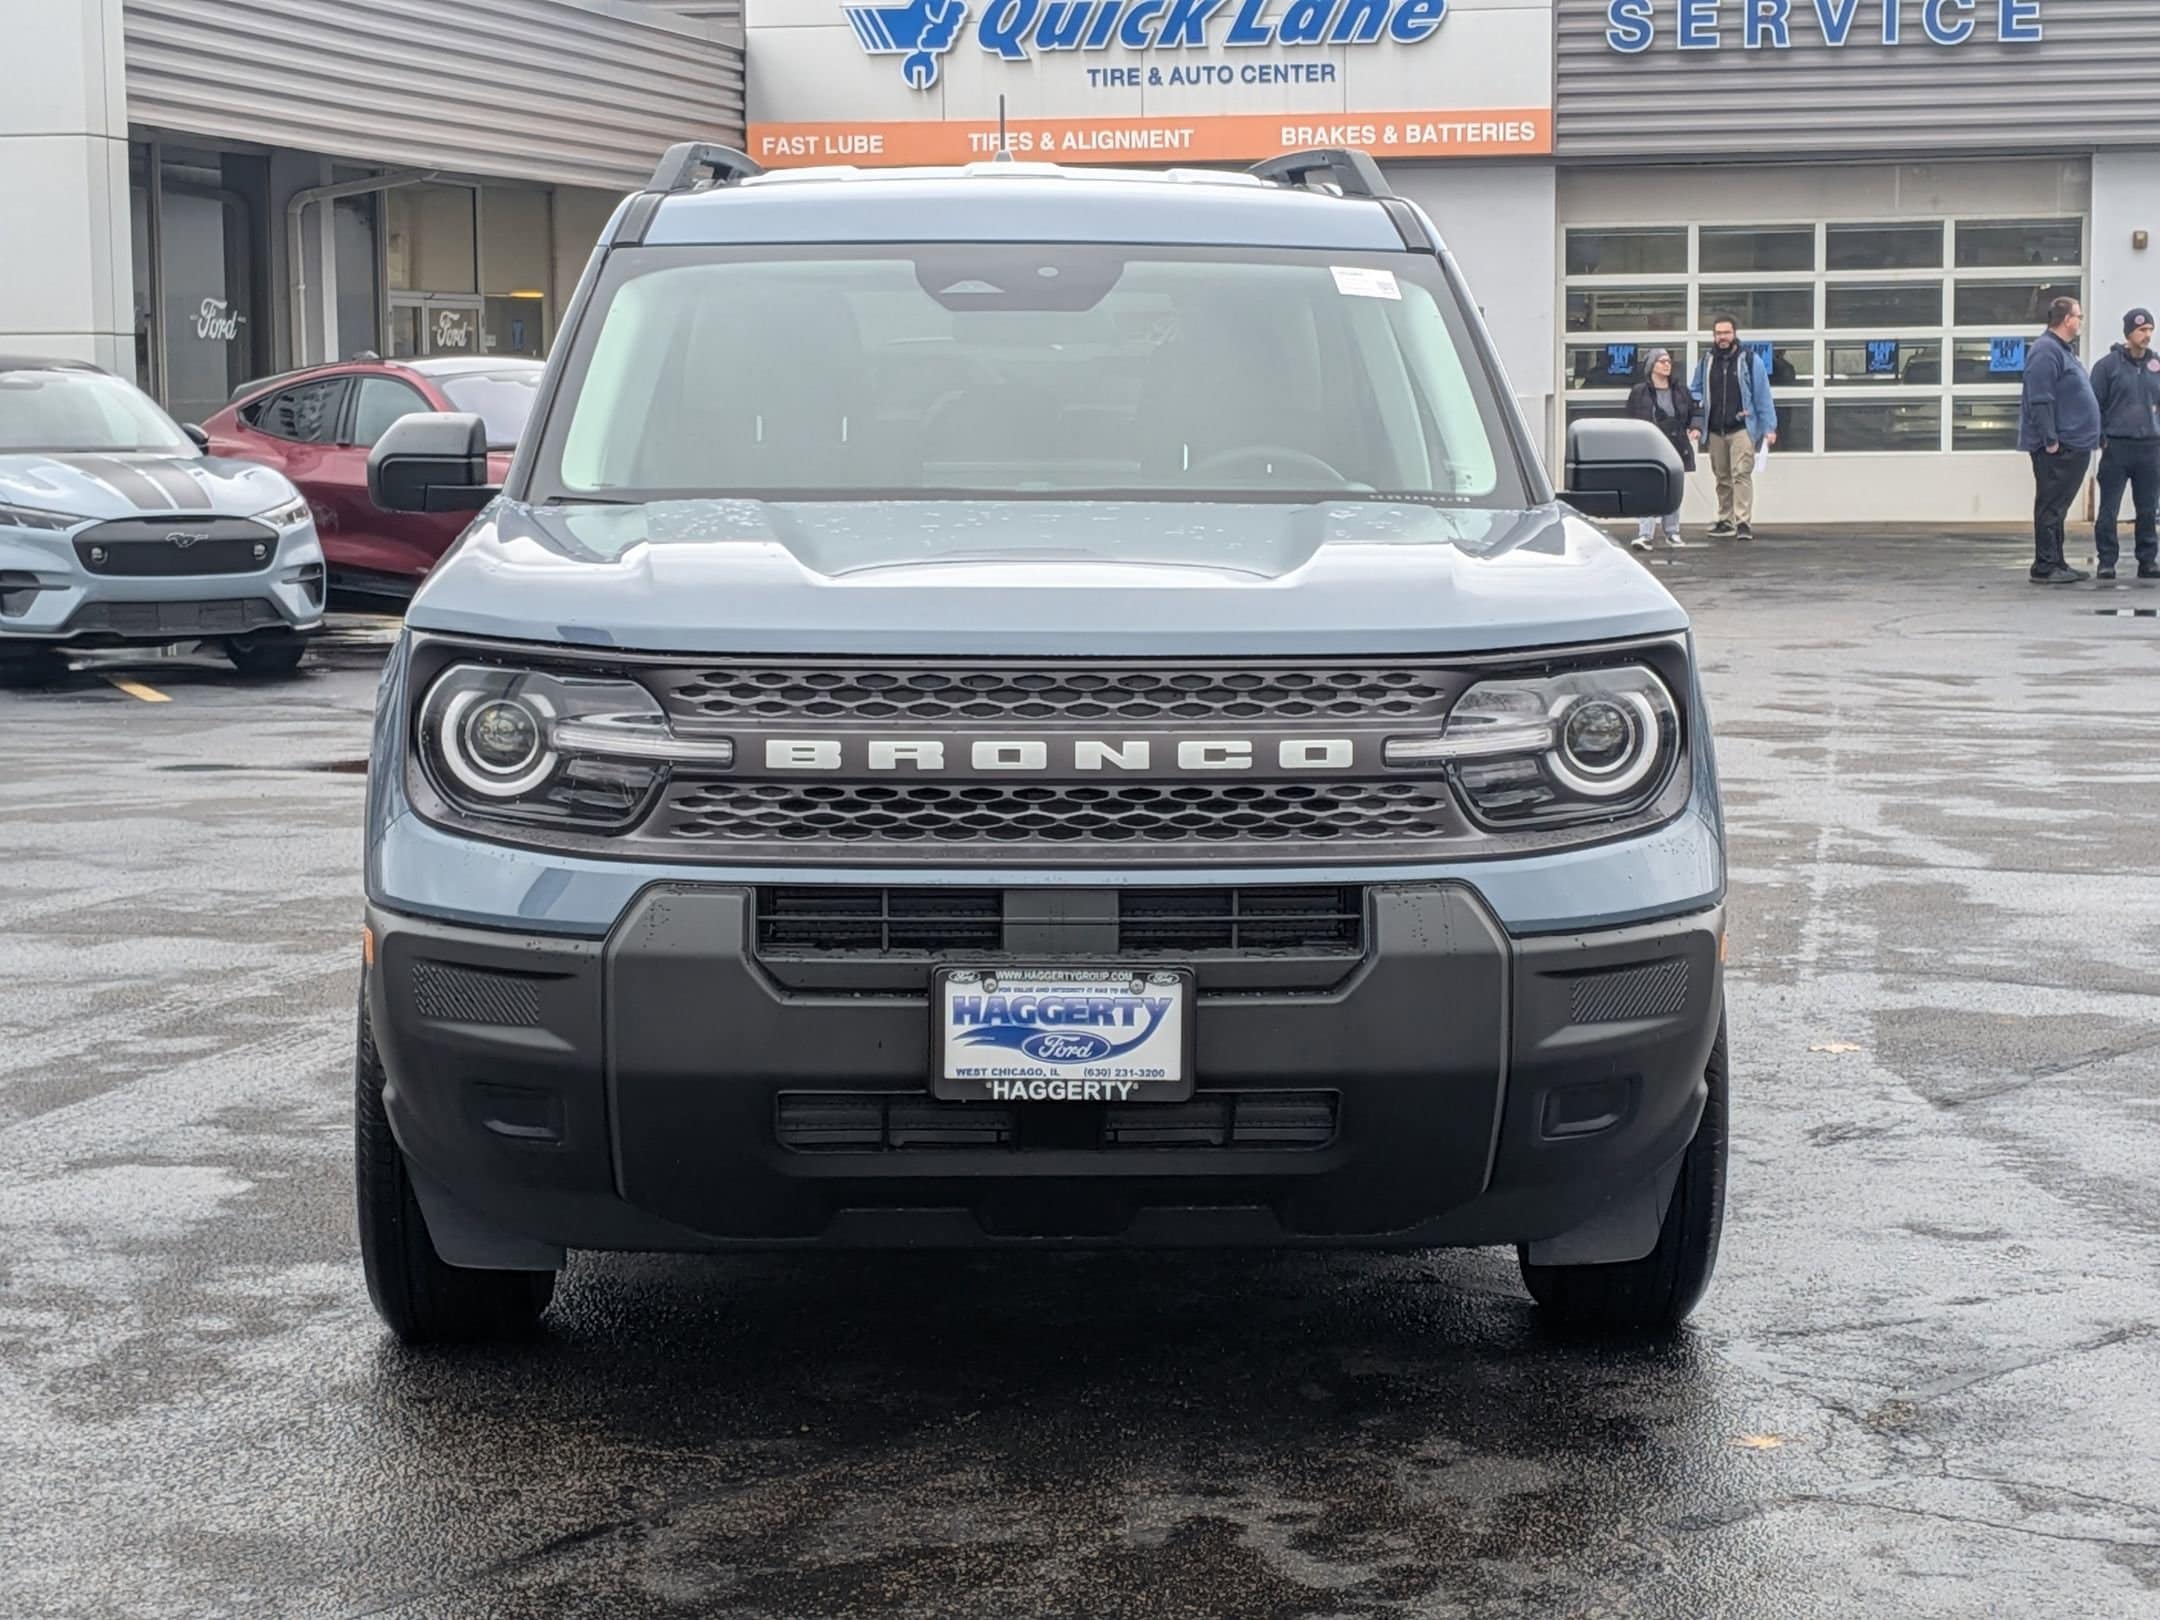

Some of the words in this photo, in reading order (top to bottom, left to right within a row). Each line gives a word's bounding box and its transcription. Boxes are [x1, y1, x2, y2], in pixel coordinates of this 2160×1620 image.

[977, 0, 1224, 60] Quick
[1223, 0, 1449, 47] Lane
[1606, 0, 2043, 52] SERVICE
[1087, 68, 1141, 87] TIRE
[1148, 67, 1163, 86] &
[1169, 65, 1234, 86] AUTO
[1241, 63, 1336, 84] CENTER
[762, 136, 819, 156] FAST
[825, 135, 884, 155] LUBE
[968, 132, 1034, 152] TIRES
[1040, 131, 1056, 151] &
[1062, 129, 1194, 150] ALIGNMENT
[1281, 125, 1377, 146] BRAKES
[1383, 124, 1398, 145] &
[1406, 122, 1536, 144] BATTERIES
[197, 298, 238, 340] Ford
[437, 311, 467, 347] Ford
[765, 739, 1354, 770] BRONCO
[995, 970, 1133, 982] WWW.HAGGERTYGROUP.COM
[952, 996, 1173, 1027] HAGGERTY
[1038, 1035, 1093, 1058] Ford
[956, 1068, 988, 1077] WEST
[991, 1068, 1047, 1078] CHICAGO,
[1050, 1068, 1060, 1077] IL
[1114, 1068, 1165, 1078] 231-3200
[993, 1081, 1132, 1100] HAGGERTY
